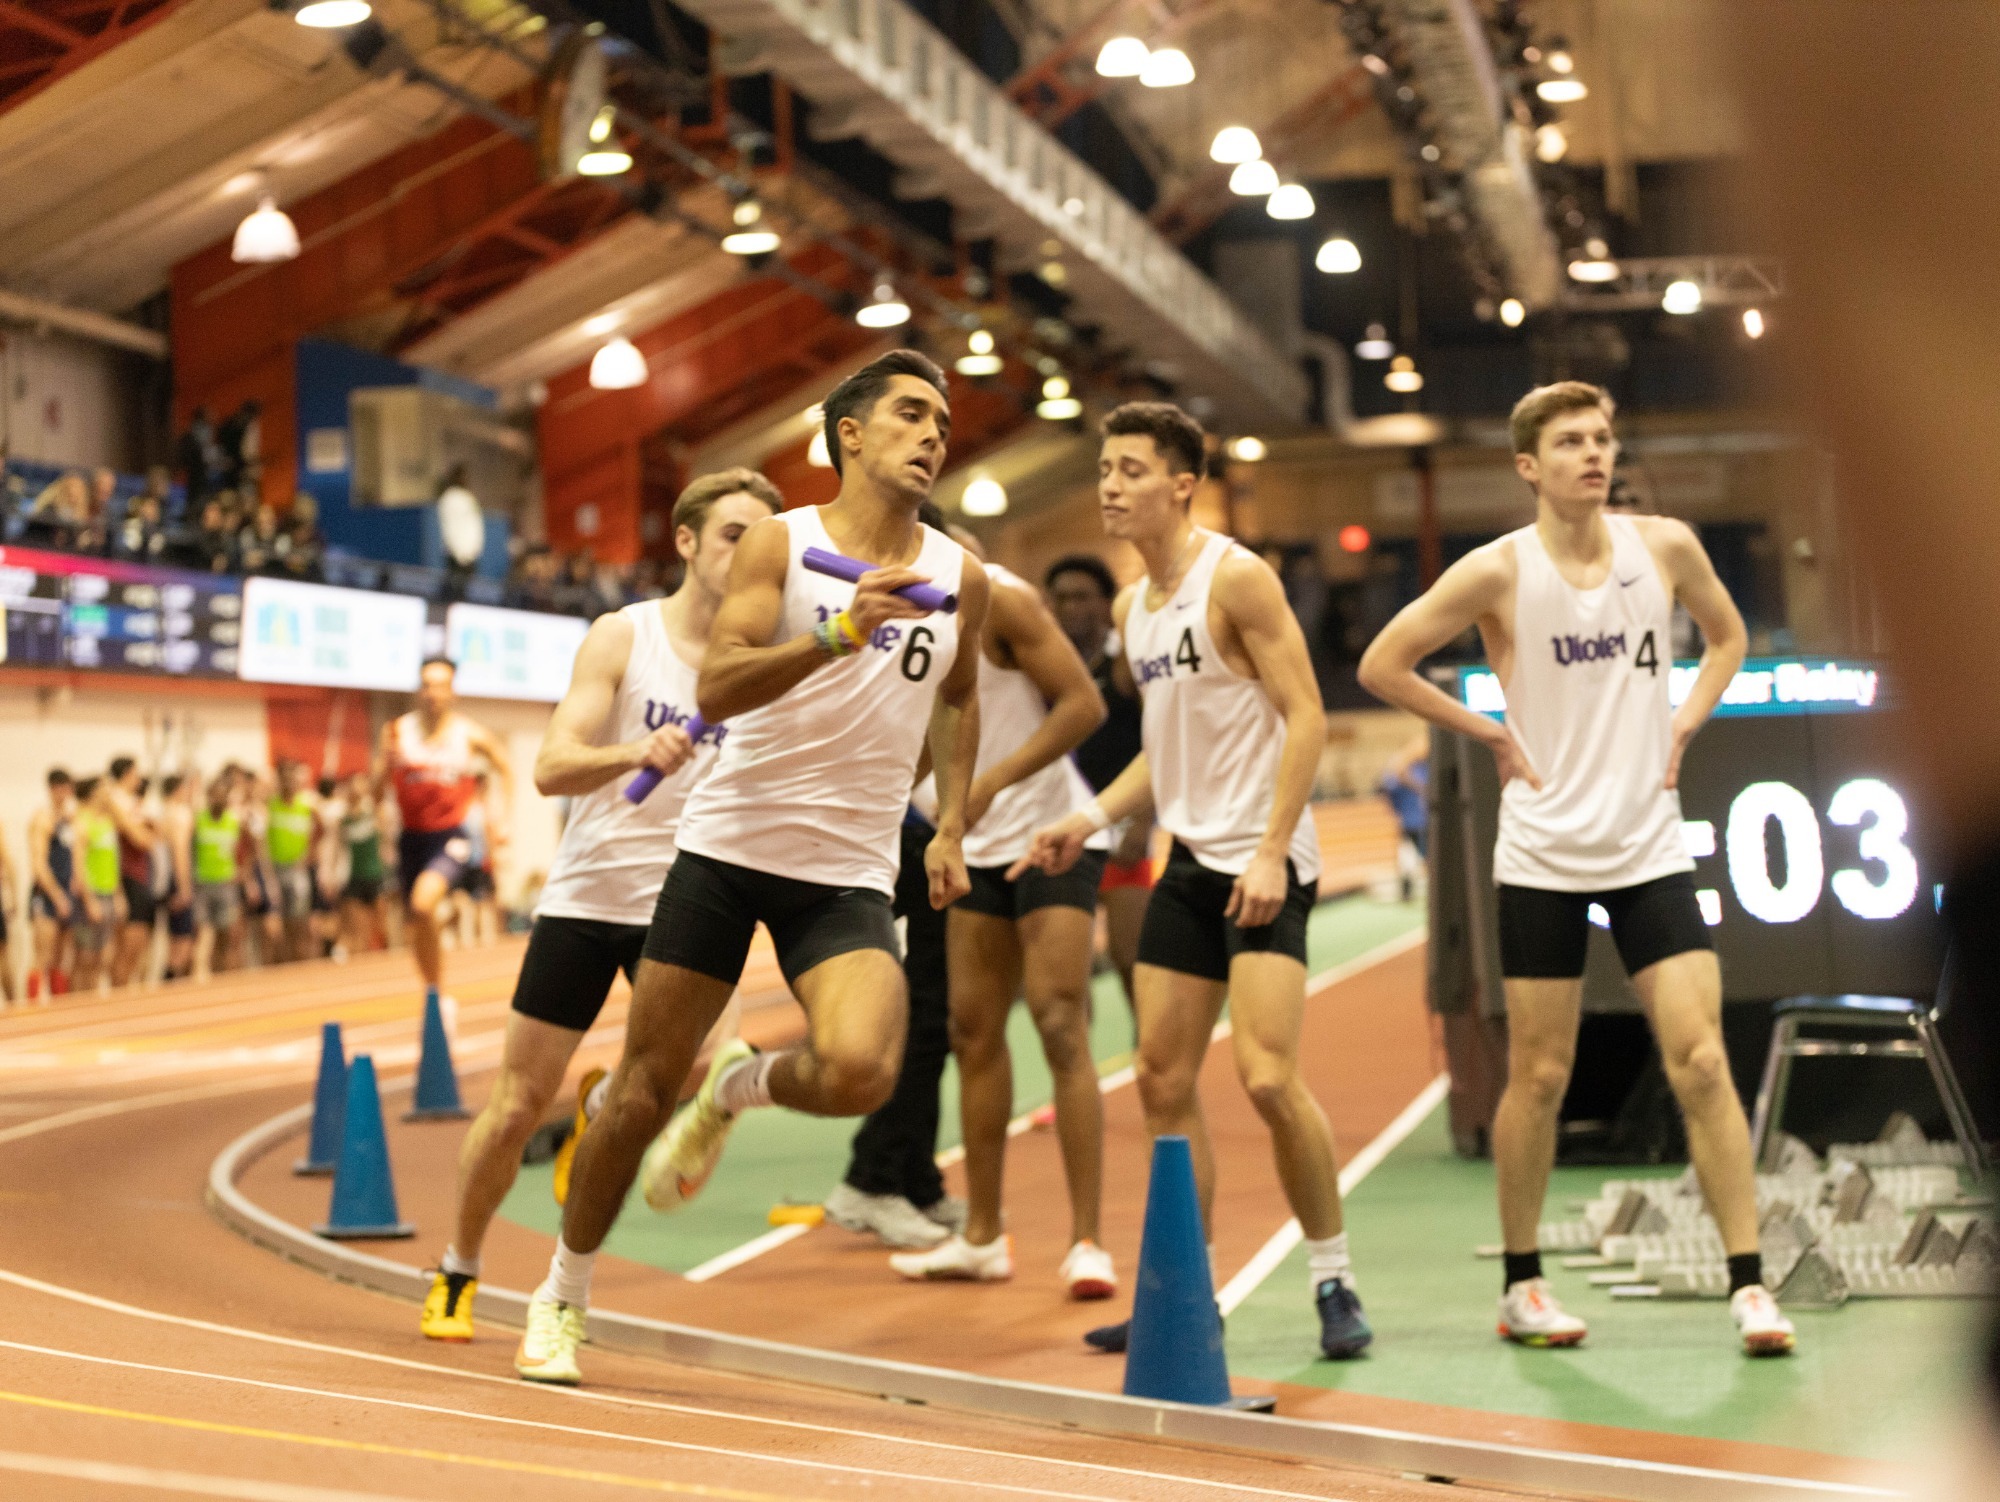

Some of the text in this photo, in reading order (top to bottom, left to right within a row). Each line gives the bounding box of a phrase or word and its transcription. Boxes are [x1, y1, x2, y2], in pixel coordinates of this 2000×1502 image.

[901, 626, 934, 682] 6
[1176, 627, 1201, 672] 4
[1551, 629, 1658, 676] Violet 4
